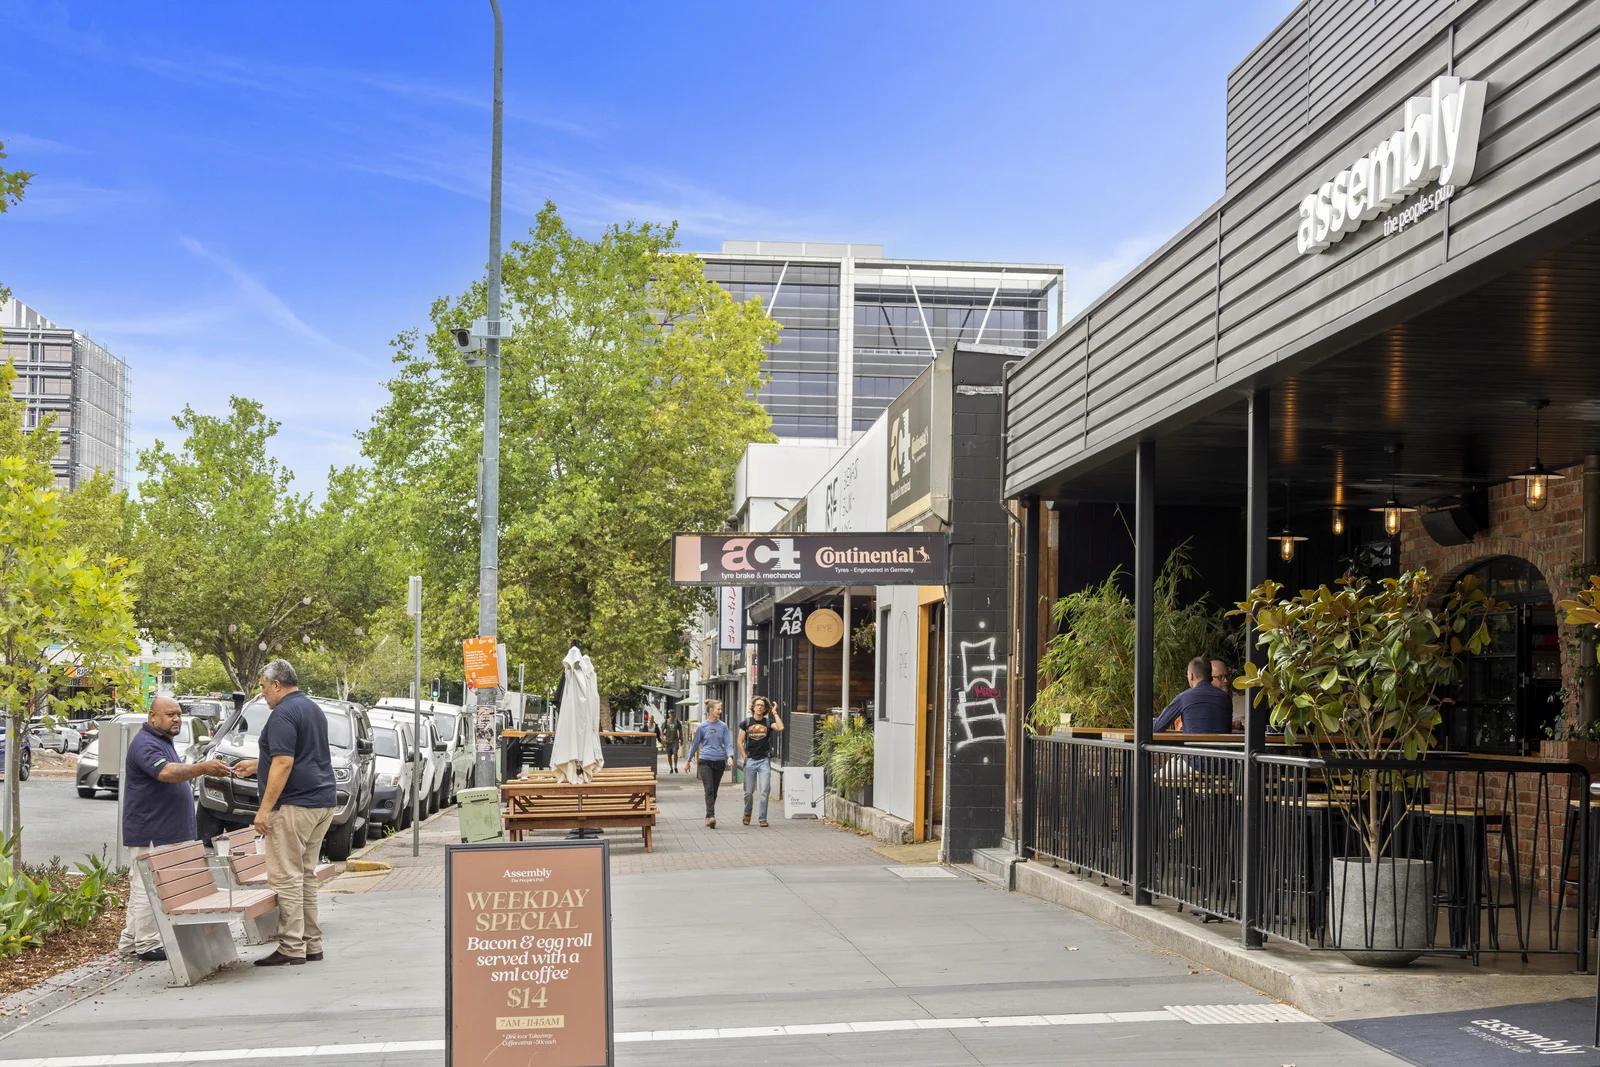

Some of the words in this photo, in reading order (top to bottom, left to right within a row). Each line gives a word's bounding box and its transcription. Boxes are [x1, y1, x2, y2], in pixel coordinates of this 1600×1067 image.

[1297, 76, 1488, 255] assembly
[1383, 216, 1399, 237] the
[721, 538, 801, 571] act
[815, 546, 914, 568] Continental
[721, 572, 735, 580] tyre
[736, 571, 755, 579] brake
[756, 571, 762, 579] &
[763, 571, 801, 579] mechanical
[816, 624, 833, 632] RYE
[503, 868, 552, 879] Assembly
[466, 889, 591, 911] WEEKDAY
[475, 911, 579, 932] SPECIAL
[466, 937, 518, 951] Bacon
[520, 935, 536, 950] &
[536, 937, 565, 953] egg
[566, 933, 593, 948] roll
[476, 951, 529, 967] served
[531, 949, 567, 965] with
[569, 952, 580, 964] a
[490, 967, 519, 982] sml
[506, 986, 549, 1009] $14
[500, 1019, 521, 1027] 7AM
[1470, 1018, 1587, 1055] assembly
